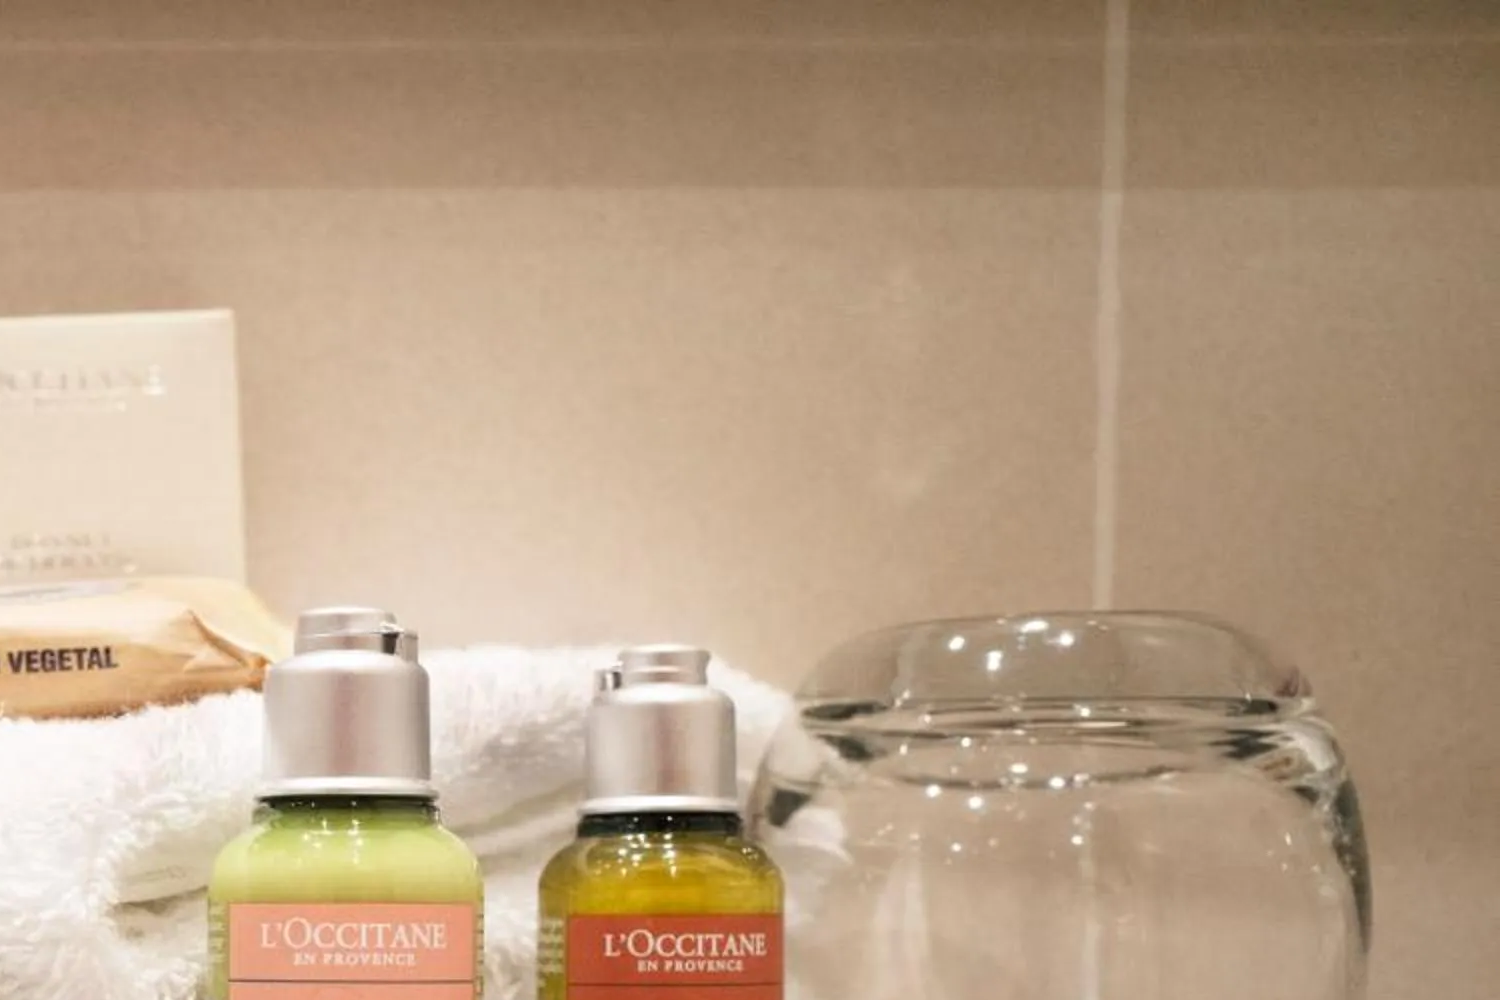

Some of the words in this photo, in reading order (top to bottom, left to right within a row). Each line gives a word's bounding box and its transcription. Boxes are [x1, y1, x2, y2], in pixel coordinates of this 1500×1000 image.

[8, 646, 120, 674] VEGETAL
[260, 917, 447, 949] L'OCCITANE
[604, 929, 768, 958] L'OCCITANE
[293, 952, 316, 966] EN
[323, 953, 416, 966] PROVENCE
[637, 960, 658, 972] EN
[663, 960, 744, 972] PROVENCE
